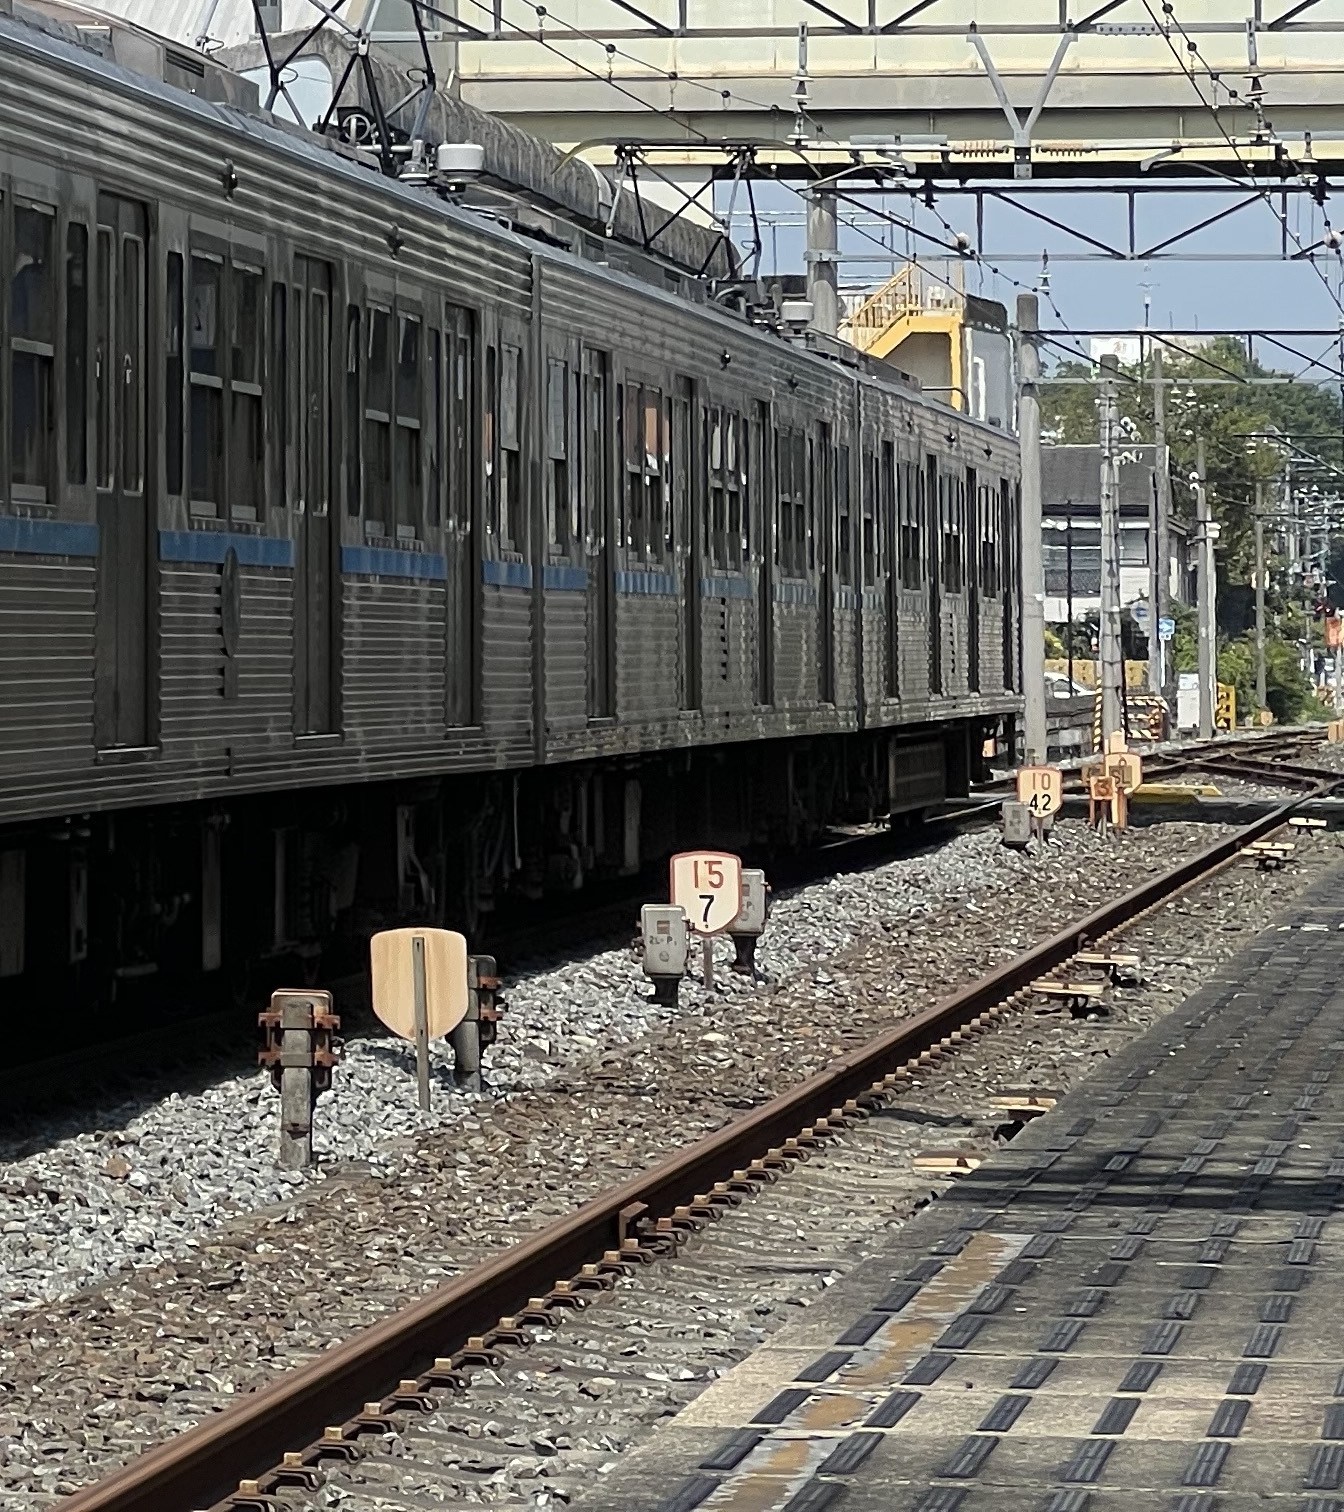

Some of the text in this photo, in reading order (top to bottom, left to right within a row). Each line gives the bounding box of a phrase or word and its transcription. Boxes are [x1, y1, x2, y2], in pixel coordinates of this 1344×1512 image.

[1032, 772, 1051, 790] 10
[1029, 793, 1051, 811] 42
[693, 860, 724, 889] 15
[698, 894, 715, 923] 7
